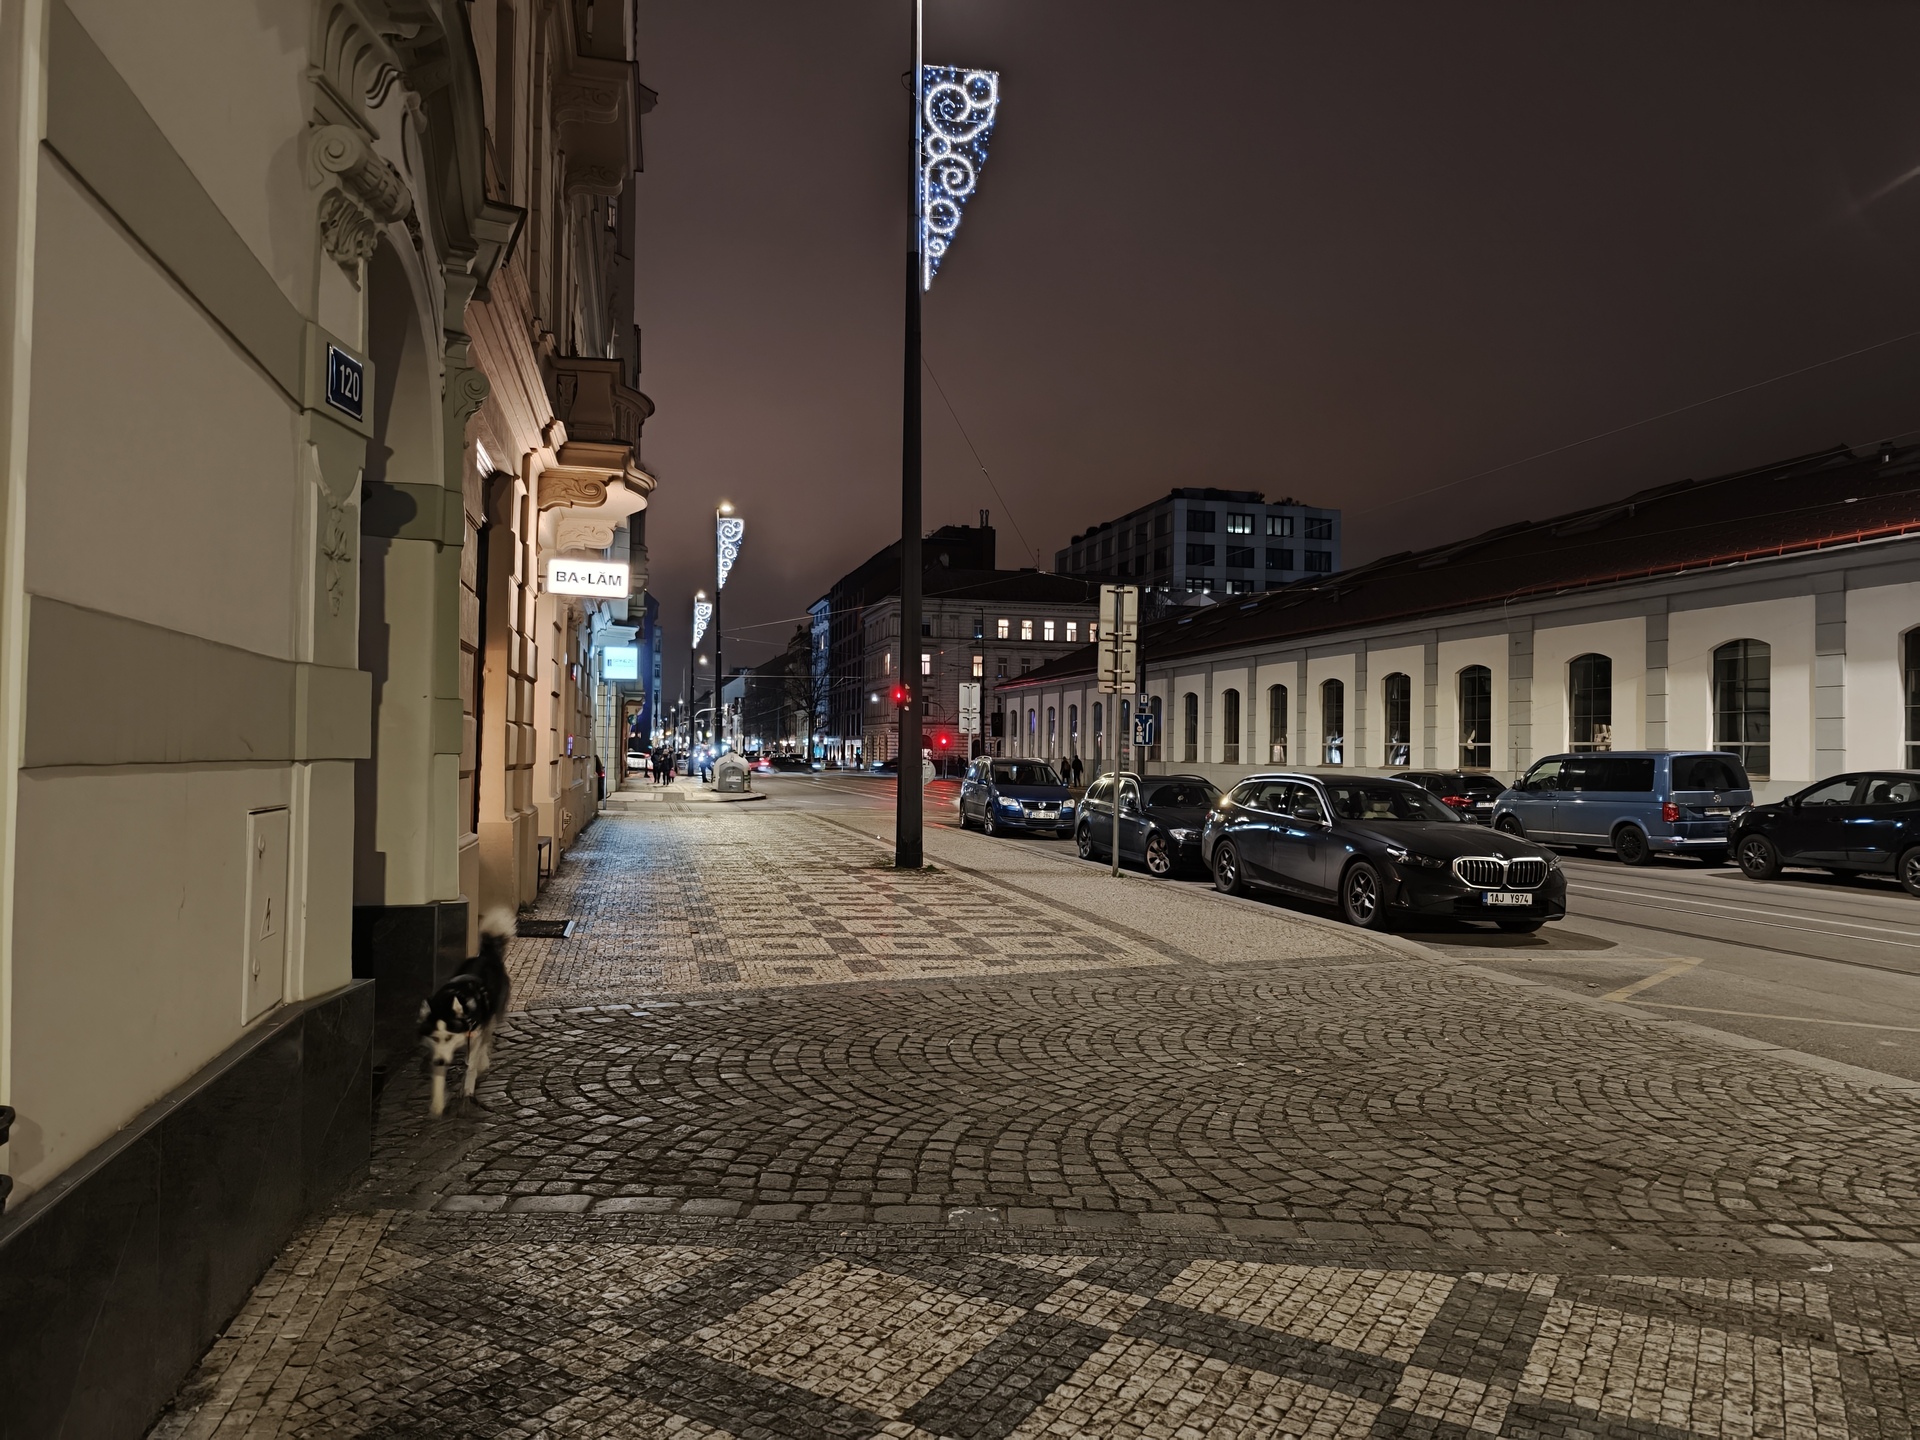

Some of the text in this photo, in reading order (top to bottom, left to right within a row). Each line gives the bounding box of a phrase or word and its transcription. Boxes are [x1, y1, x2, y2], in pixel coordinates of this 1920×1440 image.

[339, 364, 360, 402] 120
[1490, 893, 1505, 903] 1AJ
[1510, 894, 1529, 904] Y974
